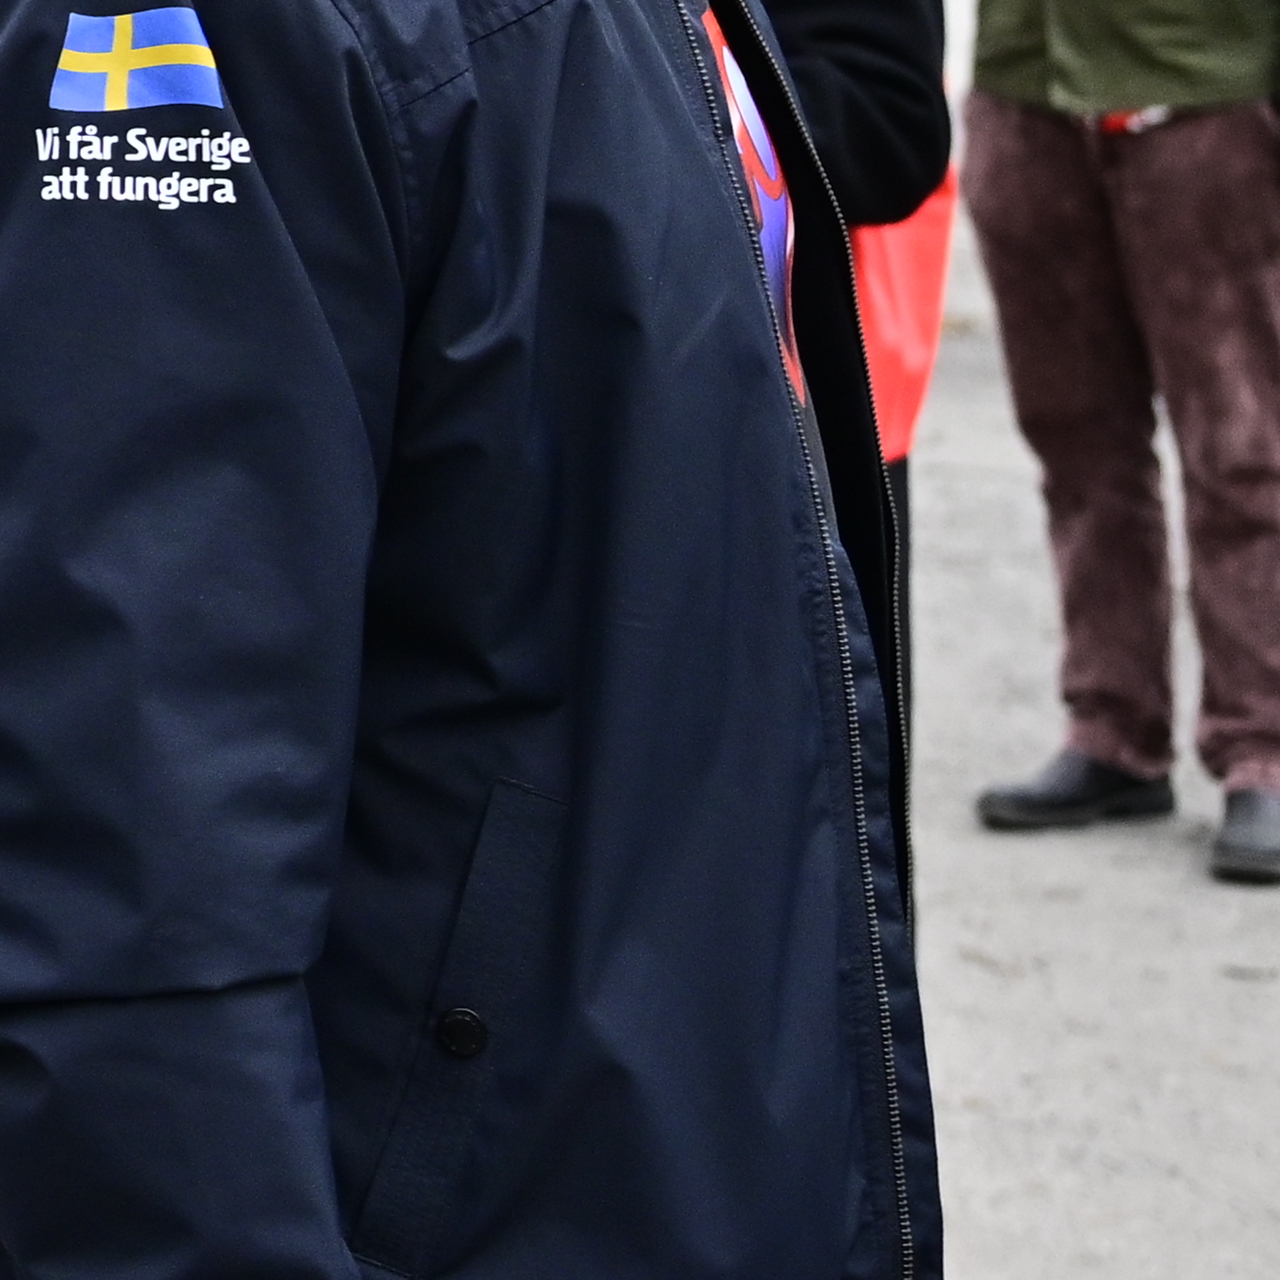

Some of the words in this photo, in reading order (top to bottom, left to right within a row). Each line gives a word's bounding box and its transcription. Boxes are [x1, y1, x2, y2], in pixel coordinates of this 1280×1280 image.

[35, 126, 60, 162] Vi
[66, 124, 119, 161] får
[124, 127, 252, 171] Sverige
[40, 166, 90, 201] att
[96, 166, 237, 210] fungera
